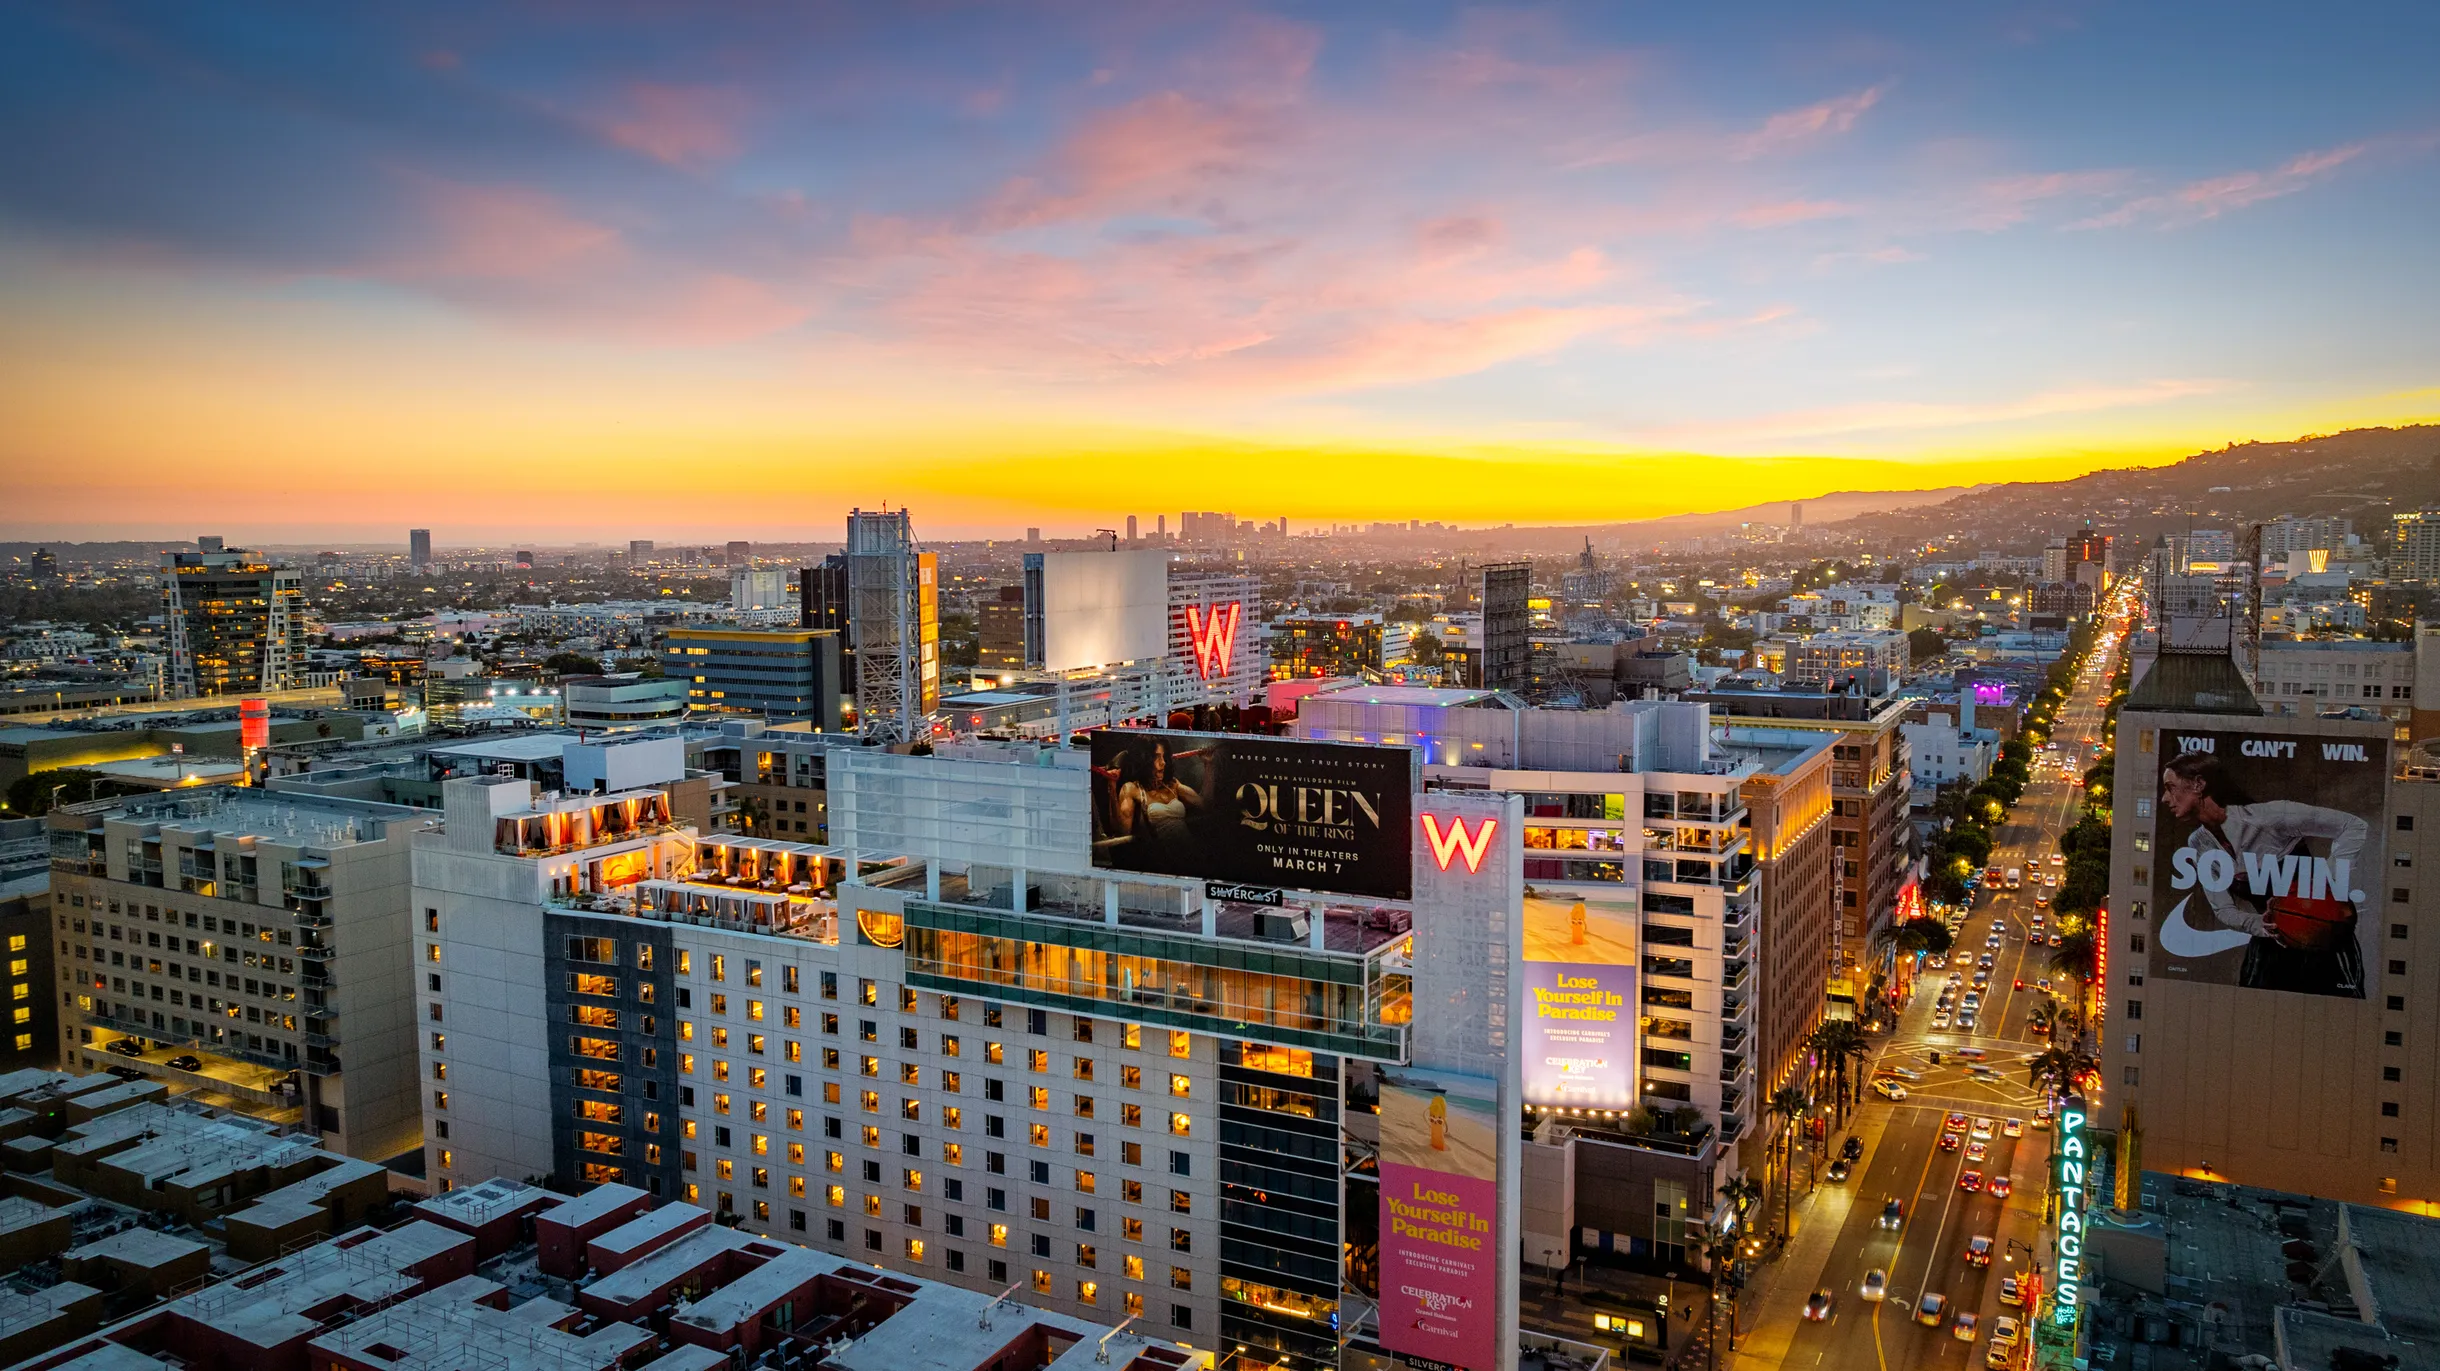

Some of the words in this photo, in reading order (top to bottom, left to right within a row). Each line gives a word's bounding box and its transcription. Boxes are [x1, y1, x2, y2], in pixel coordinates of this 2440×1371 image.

[1187, 602, 1240, 680] W
[2177, 736, 2215, 754] YOU
[2241, 740, 2297, 759] CAN'T
[2322, 743, 2369, 762] WIN.
[1232, 754, 1267, 762] BASED
[1312, 759, 1338, 767] TRUE
[1348, 761, 1385, 769] STORY
[1293, 776, 1333, 784] AVILDSEN
[1236, 782, 1381, 831] QUEEN
[1274, 823, 1291, 835] OF
[1294, 824, 1320, 838] THE
[1324, 828, 1354, 840] RING
[1257, 844, 1284, 854] ONLY
[1288, 847, 1299, 855] IN
[1303, 849, 1359, 861] THEATERS
[1420, 813, 1498, 874] W
[1273, 857, 1327, 872] MARCH
[1334, 863, 1342, 874] 7
[2171, 847, 2235, 892] SO
[2243, 852, 2366, 903] WIN.
[1834, 855, 1842, 911] TAFT
[1833, 920, 1841, 975] BLDG
[1557, 973, 1598, 989] Lose
[1532, 987, 1604, 1005] Yourself
[1605, 990, 1623, 1006] In
[1538, 1003, 1616, 1022] Paradise
[1544, 1028, 1580, 1036] INTRODUCING
[1413, 1182, 1460, 1208] Lose
[1386, 1196, 1466, 1228] Yourself
[1469, 1212, 1489, 1233] In
[2058, 1111, 2084, 1305] PANTAGES
[1392, 1217, 1481, 1251] Paradise
[1398, 1249, 1440, 1263] INTRODUCING
[1441, 1258, 1475, 1271] CARNIVAL'S
[1405, 1258, 1437, 1271] EXCLUSIVE
[1438, 1265, 1468, 1278] PARADISE
[1401, 1285, 1472, 1309] CELEBRATION
[1427, 1299, 1447, 1311] KEY
[1415, 1308, 1433, 1317] Grand
[1420, 1322, 1459, 1338] Carnival
